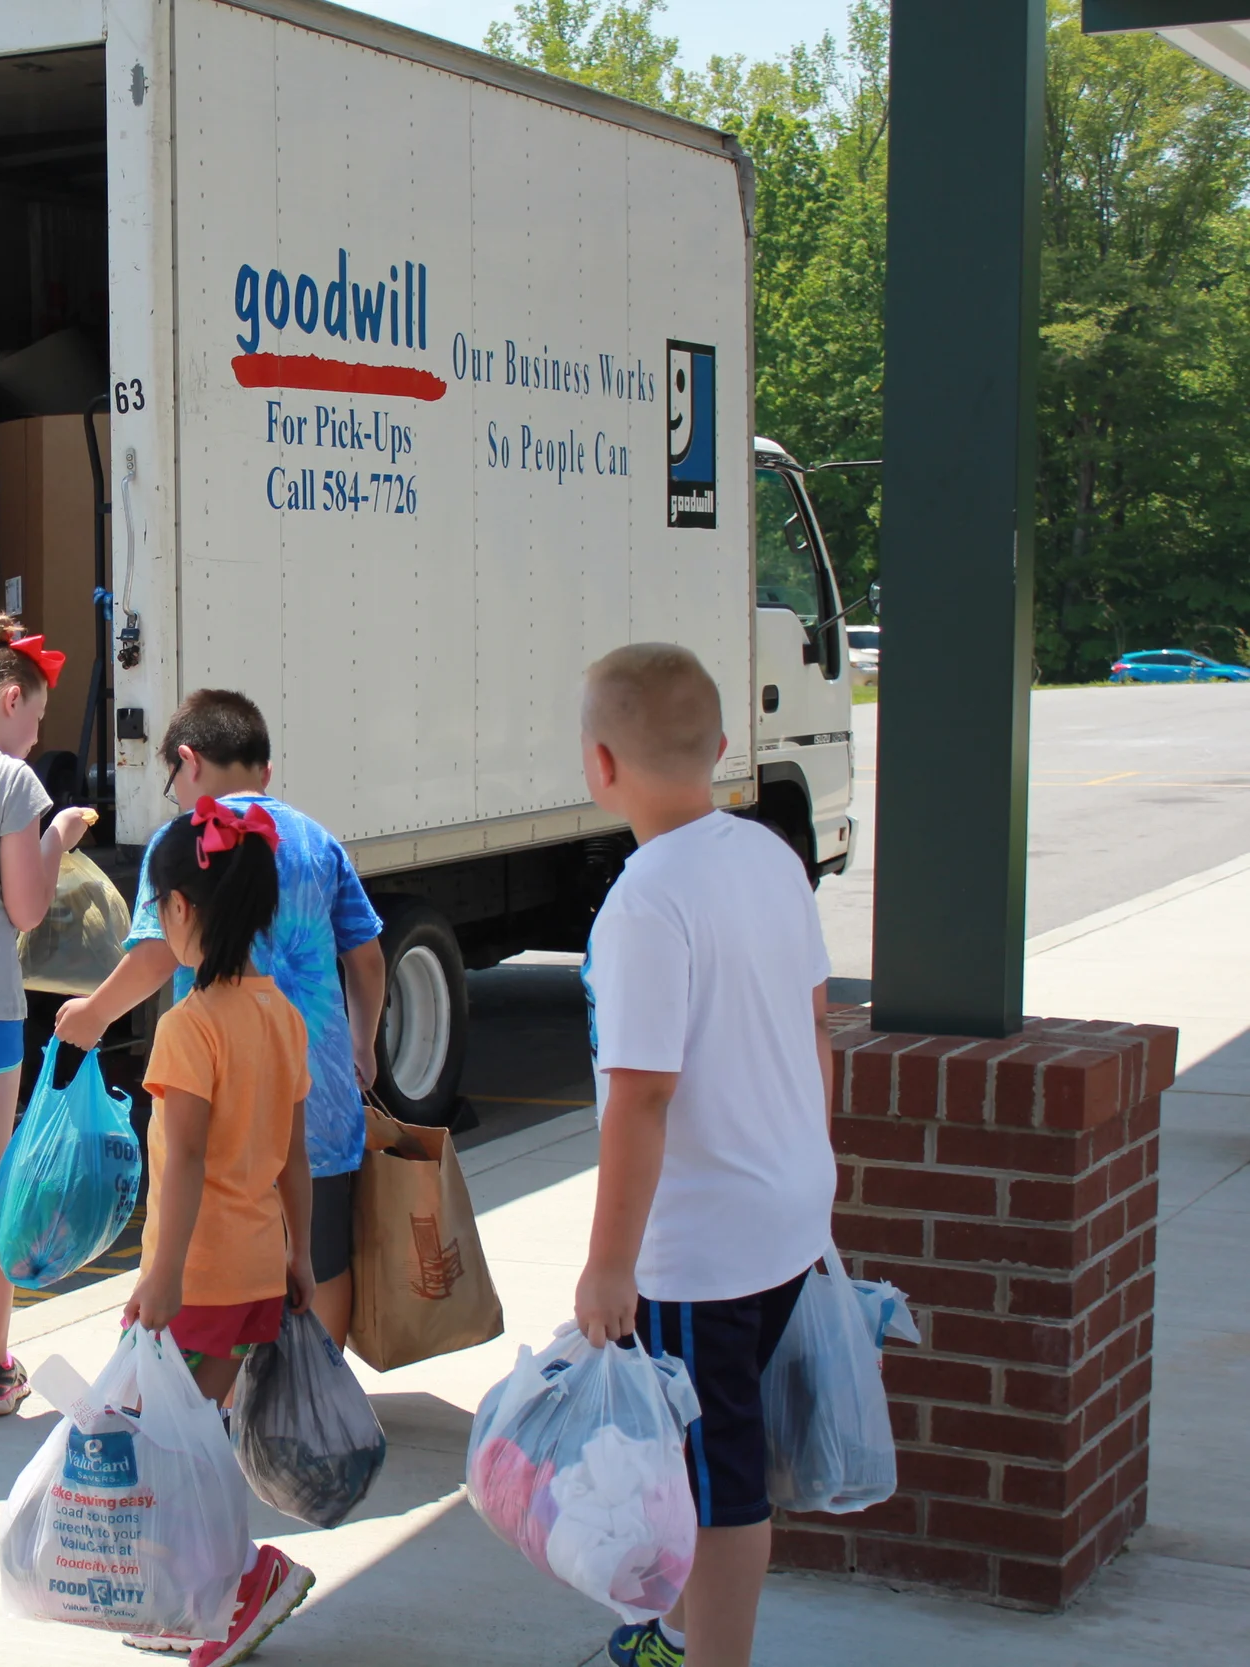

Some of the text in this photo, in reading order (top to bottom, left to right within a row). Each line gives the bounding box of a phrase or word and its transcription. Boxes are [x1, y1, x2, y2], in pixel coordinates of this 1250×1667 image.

[235, 248, 428, 354] goodwill
[453, 332, 655, 402] Our Business Works
[115, 378, 145, 414] 63
[267, 400, 412, 464] For Pick-Ups
[488, 421, 629, 485] So People Can
[266, 466, 418, 515] Call 584-7726
[671, 490, 714, 522] goodwill
[68, 1449, 130, 1473] ValuCard
[51, 1483, 72, 1501] ake
[74, 1493, 116, 1511] saving
[56, 1502, 83, 1518] Load
[53, 1519, 141, 1542] directly to your
[60, 1536, 132, 1556] ValuCard at
[56, 1555, 139, 1575] foodcity.com
[49, 1579, 144, 1604] FOOD CITY
